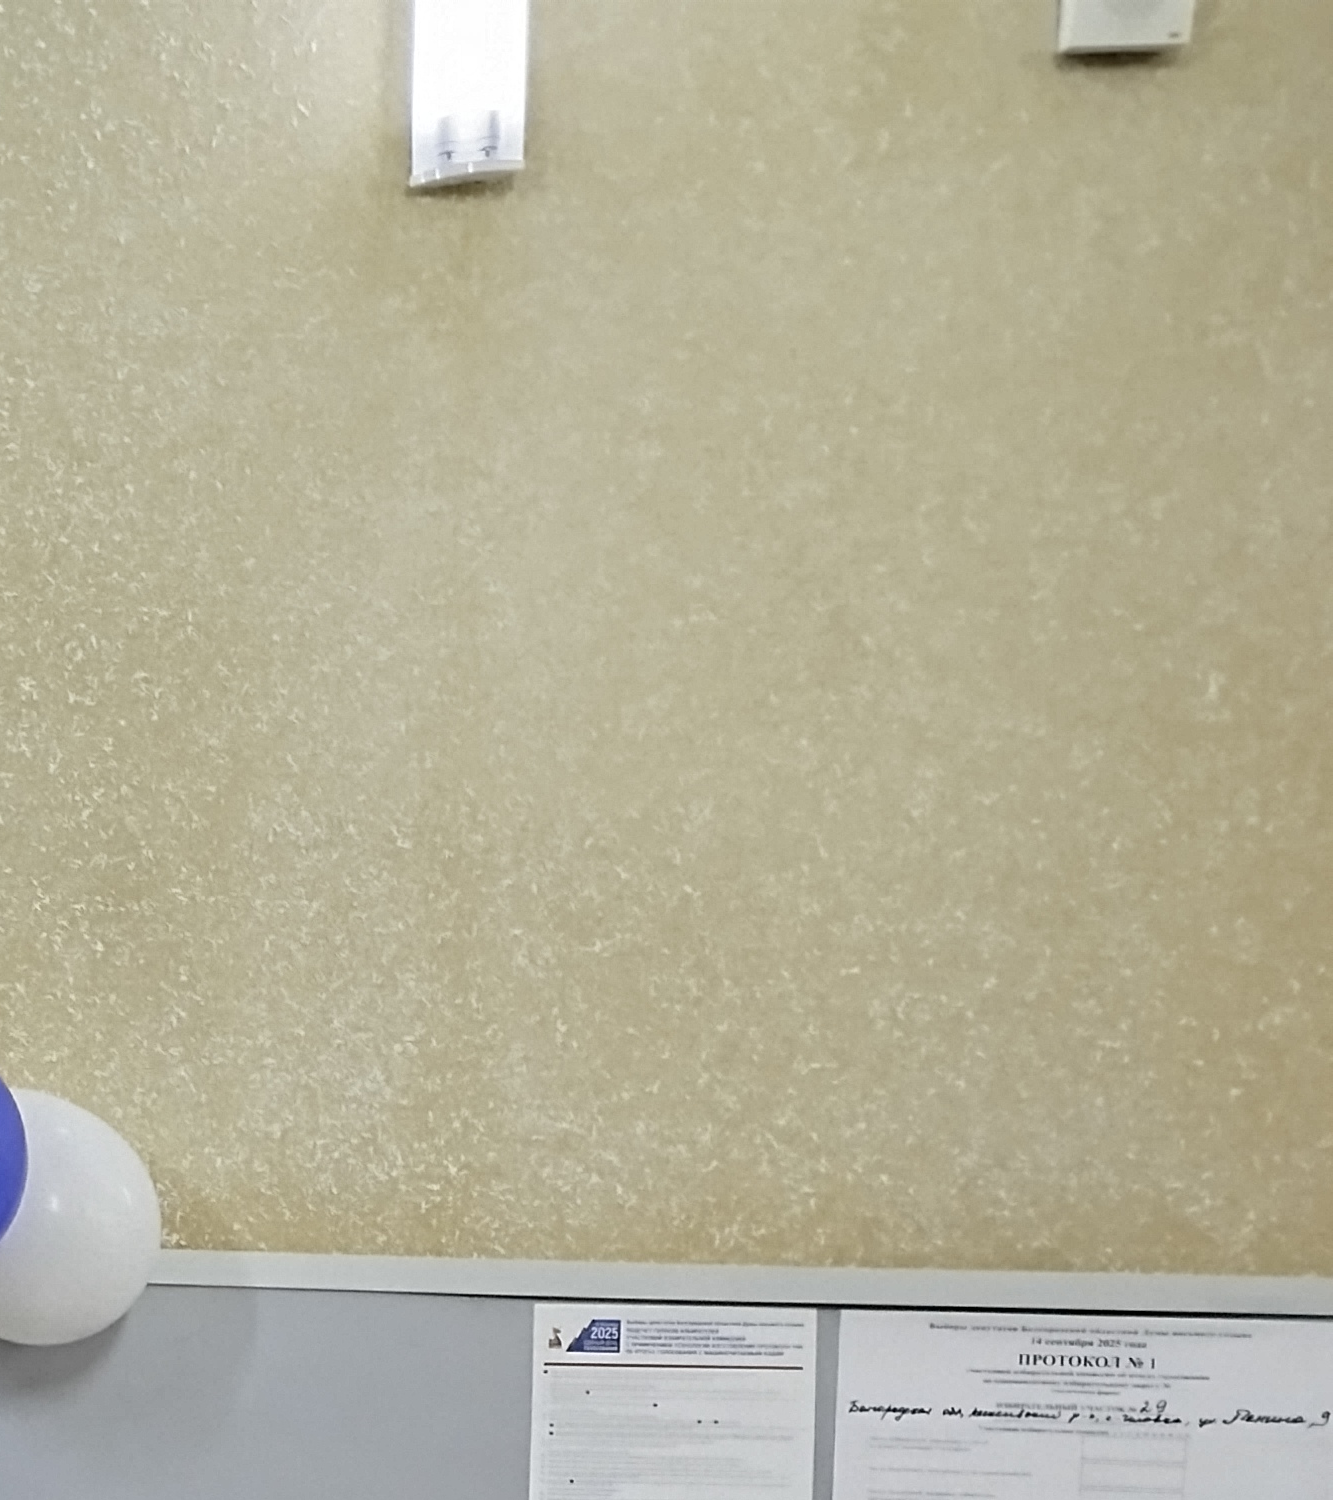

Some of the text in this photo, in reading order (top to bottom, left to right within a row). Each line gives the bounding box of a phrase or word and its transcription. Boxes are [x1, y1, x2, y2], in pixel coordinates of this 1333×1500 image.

[590, 1326, 619, 1340] 2025
[1018, 1353, 1156, 1369] ПРОТОКОЛ № 1
